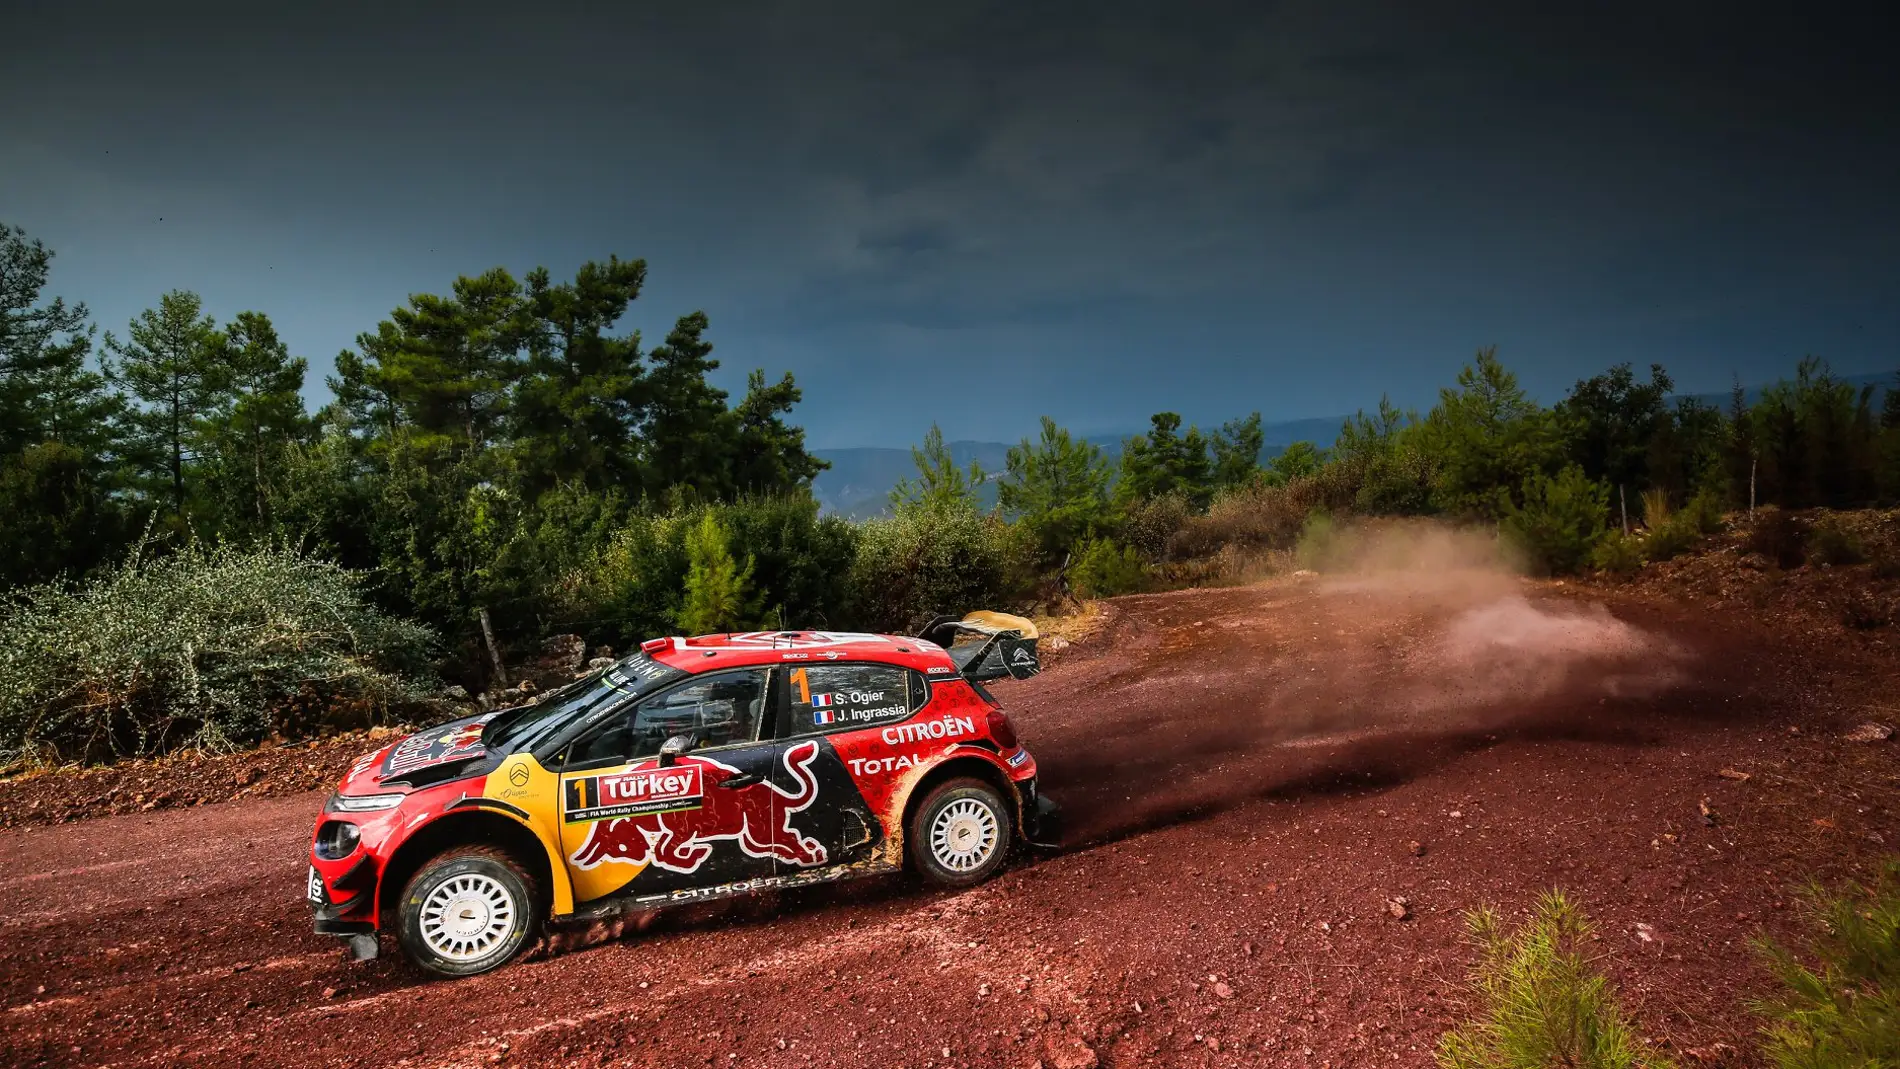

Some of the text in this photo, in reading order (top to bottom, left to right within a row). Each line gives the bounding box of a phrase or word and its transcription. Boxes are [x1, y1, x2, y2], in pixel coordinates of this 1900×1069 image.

[790, 667, 811, 704] 1
[835, 690, 884, 706] S. Ogier
[837, 703, 906, 722] J. Ingrassia
[881, 714, 975, 745] CITROËN
[848, 753, 925, 776] TOTAL
[574, 779, 587, 809] 1
[604, 774, 694, 799] Turkey
[600, 809, 617, 817] World
[617, 807, 631, 816] Rally
[631, 803, 669, 813] Championship
